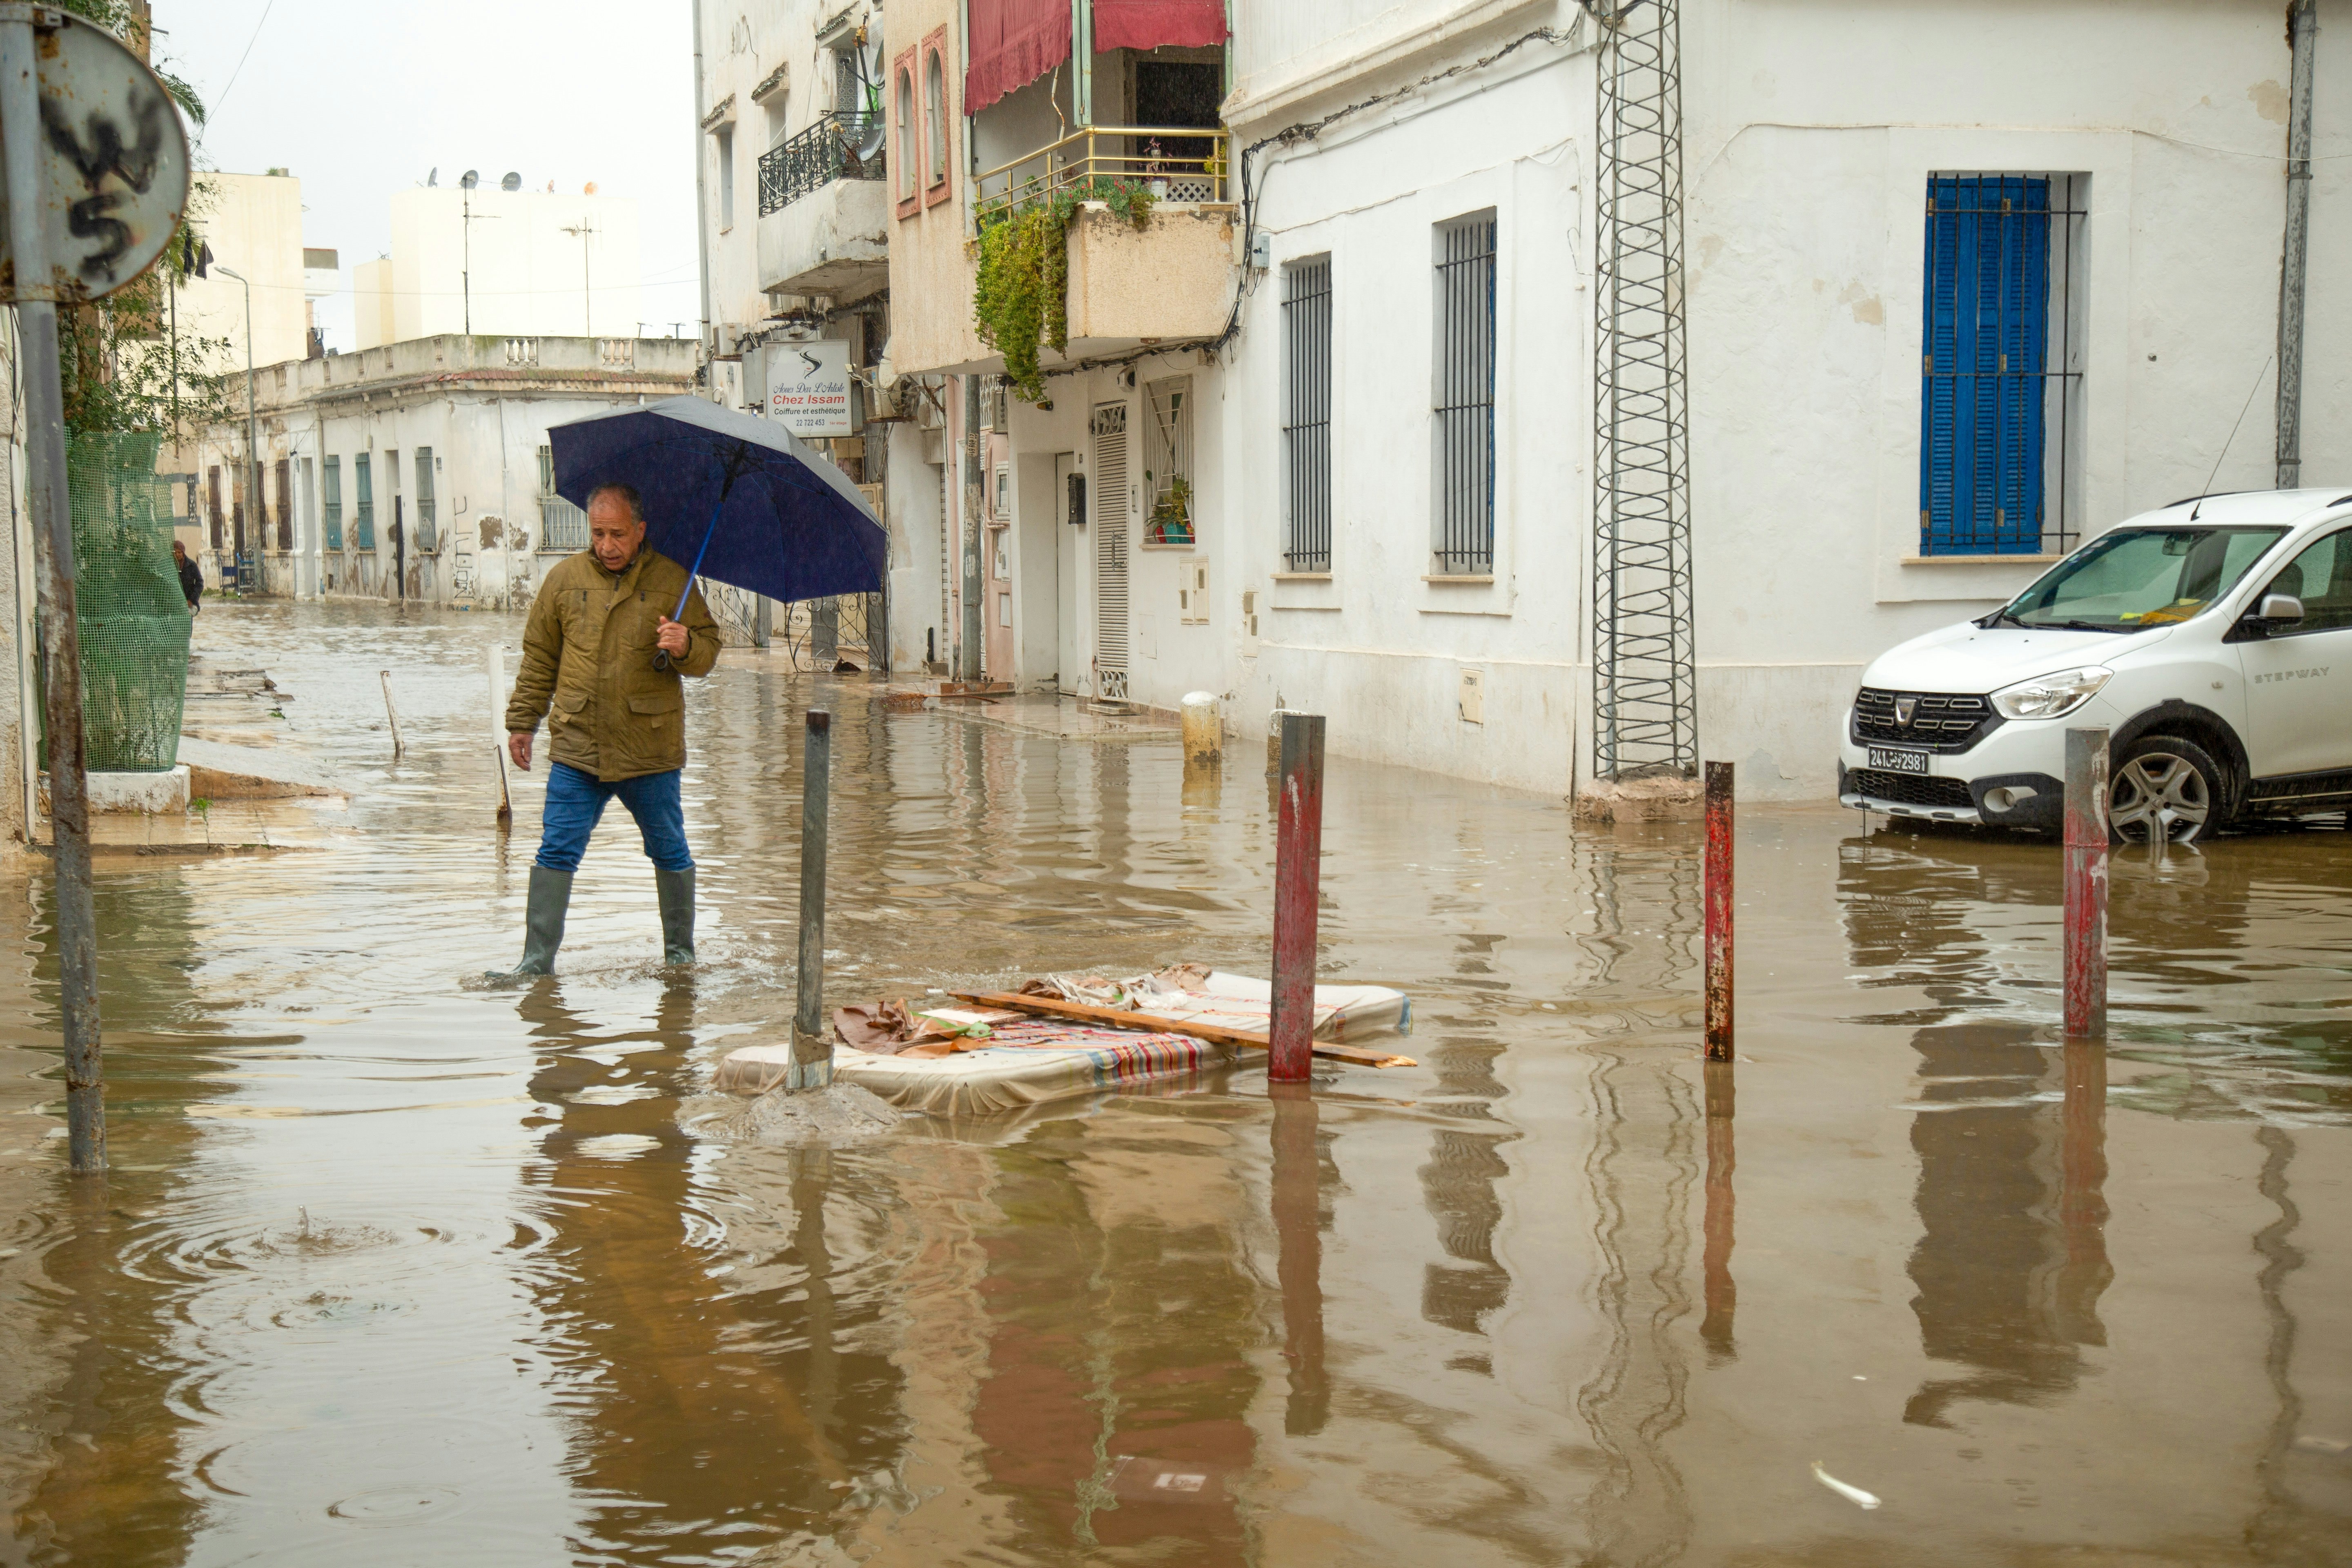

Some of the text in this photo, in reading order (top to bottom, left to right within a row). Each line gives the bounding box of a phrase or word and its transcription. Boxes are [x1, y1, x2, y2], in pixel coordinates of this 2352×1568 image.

[795, 383, 811, 393] Dar
[773, 395, 844, 405] Chez Issam
[2254, 667, 2329, 684] STEPWAY
[1871, 750, 1886, 767] 241
